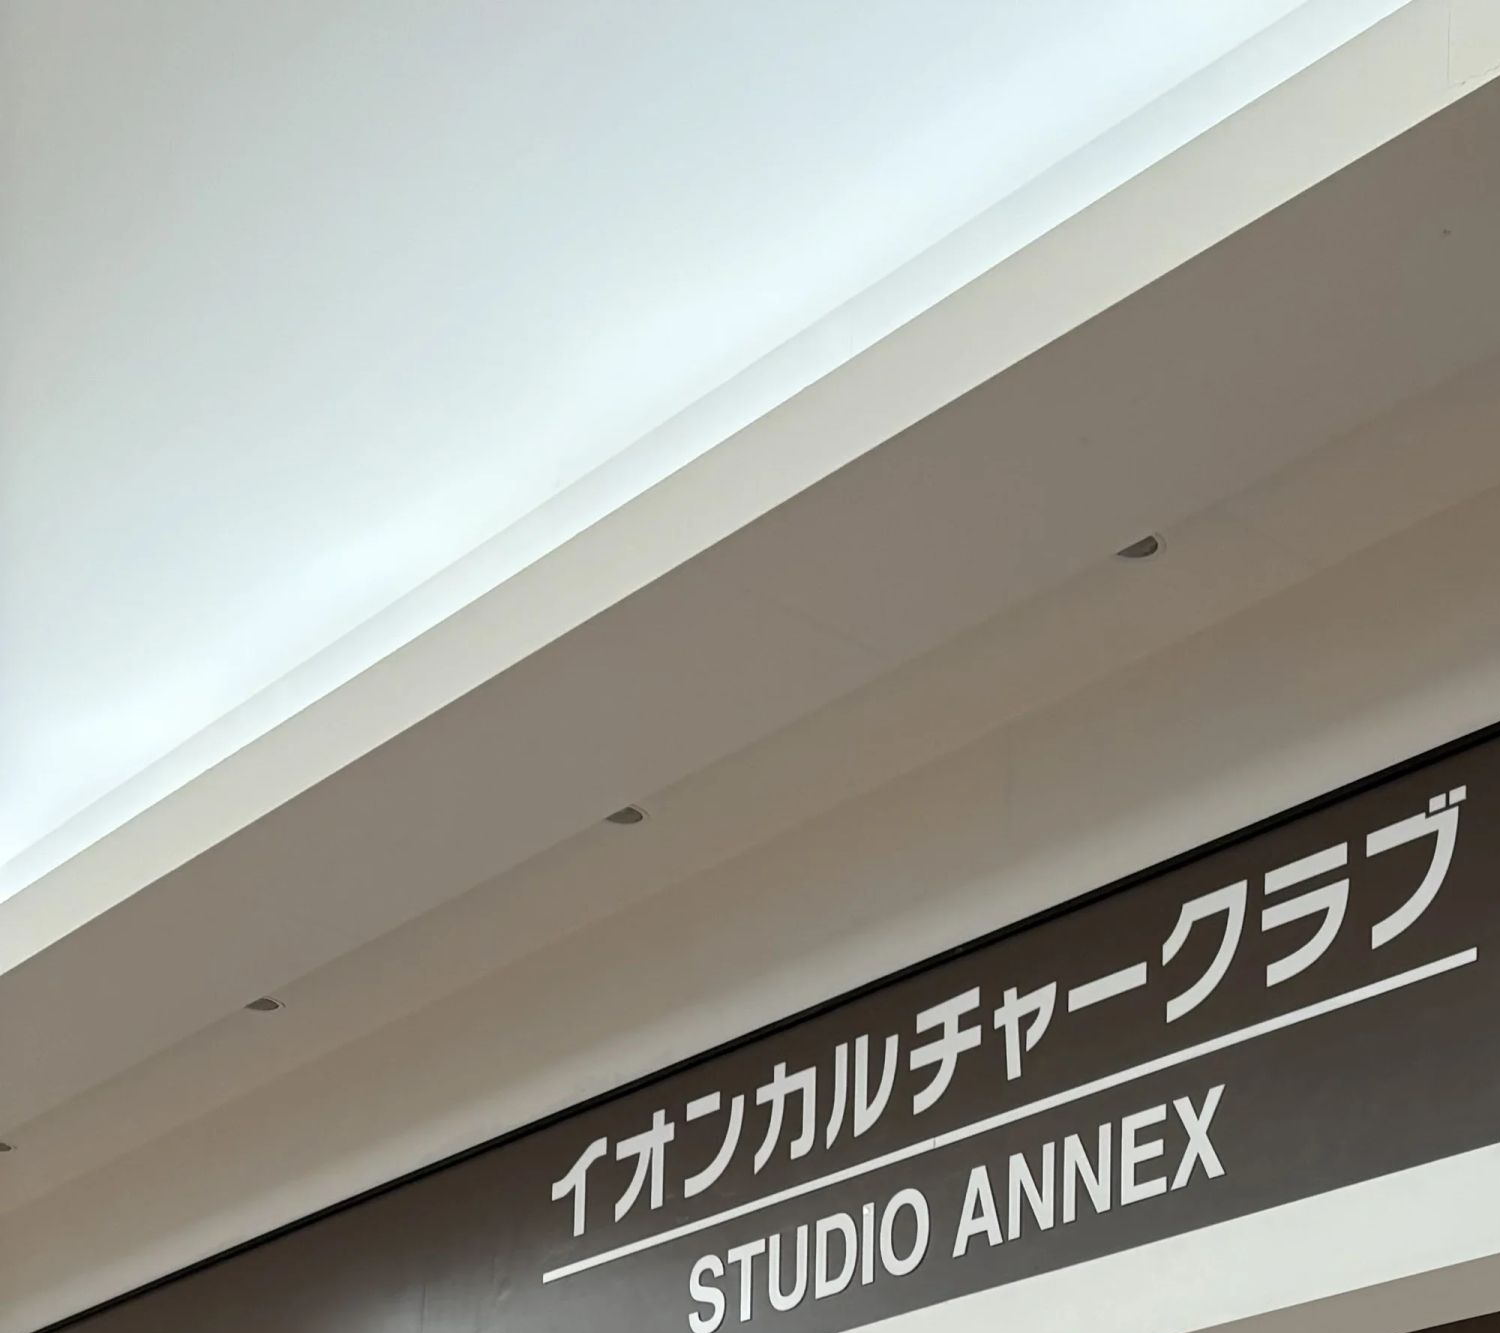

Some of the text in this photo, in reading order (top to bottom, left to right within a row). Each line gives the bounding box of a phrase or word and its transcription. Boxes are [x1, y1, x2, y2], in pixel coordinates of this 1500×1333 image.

[552, 785, 1466, 1237] イオンカルチャークラブ
[952, 1084, 1227, 1259] ANNEX
